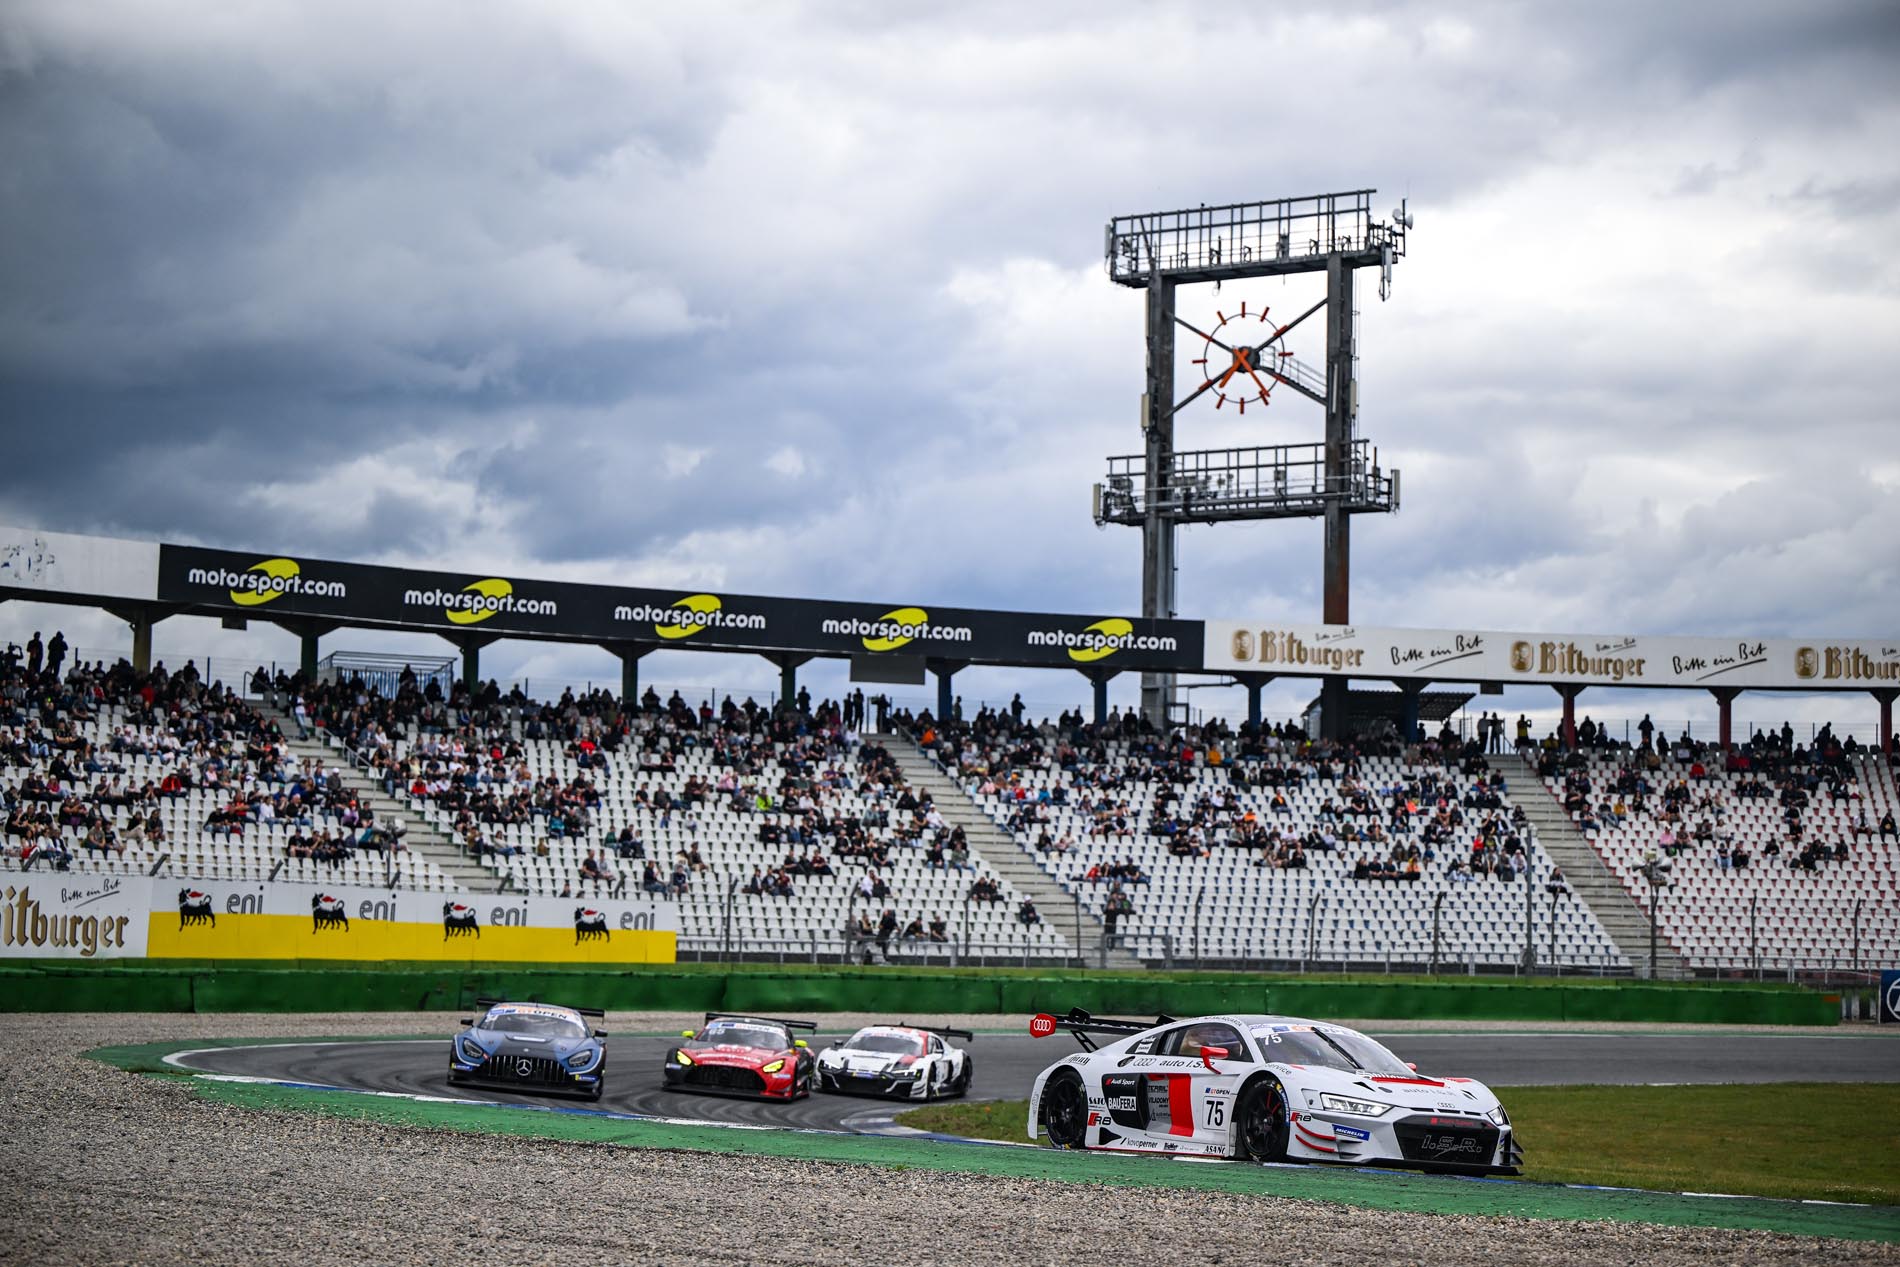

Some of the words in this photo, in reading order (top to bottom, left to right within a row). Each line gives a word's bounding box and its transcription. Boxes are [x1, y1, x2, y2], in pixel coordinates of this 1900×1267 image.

[189, 567, 346, 597] motorsport.com
[404, 588, 557, 616] motorsport.com
[614, 604, 766, 630] motorsport.com
[822, 617, 972, 641] motorsport.com
[1028, 629, 1177, 652] motorsport.com
[1258, 629, 1364, 671] Bitburger
[1390, 646, 1425, 665] Bitte
[1431, 648, 1451, 659] ein
[1455, 634, 1483, 652] Bit
[1538, 640, 1646, 681] Bitburger
[1673, 656, 1708, 675] Bitte
[1713, 655, 1735, 667] ein
[1739, 642, 1767, 660] Bit
[1823, 646, 1900, 682] Bitbur
[227, 885, 264, 915] eni
[359, 893, 397, 922] eni
[490, 900, 528, 927] eni
[0, 885, 130, 957] itburger
[620, 904, 656, 931] eni
[1264, 1033, 1282, 1046] 75
[1160, 1058, 1185, 1068] auto
[1093, 1114, 1112, 1126] R8
[1206, 1100, 1225, 1127] 75
[1293, 1113, 1312, 1122] R8
[1335, 1127, 1366, 1138] MICHELIN
